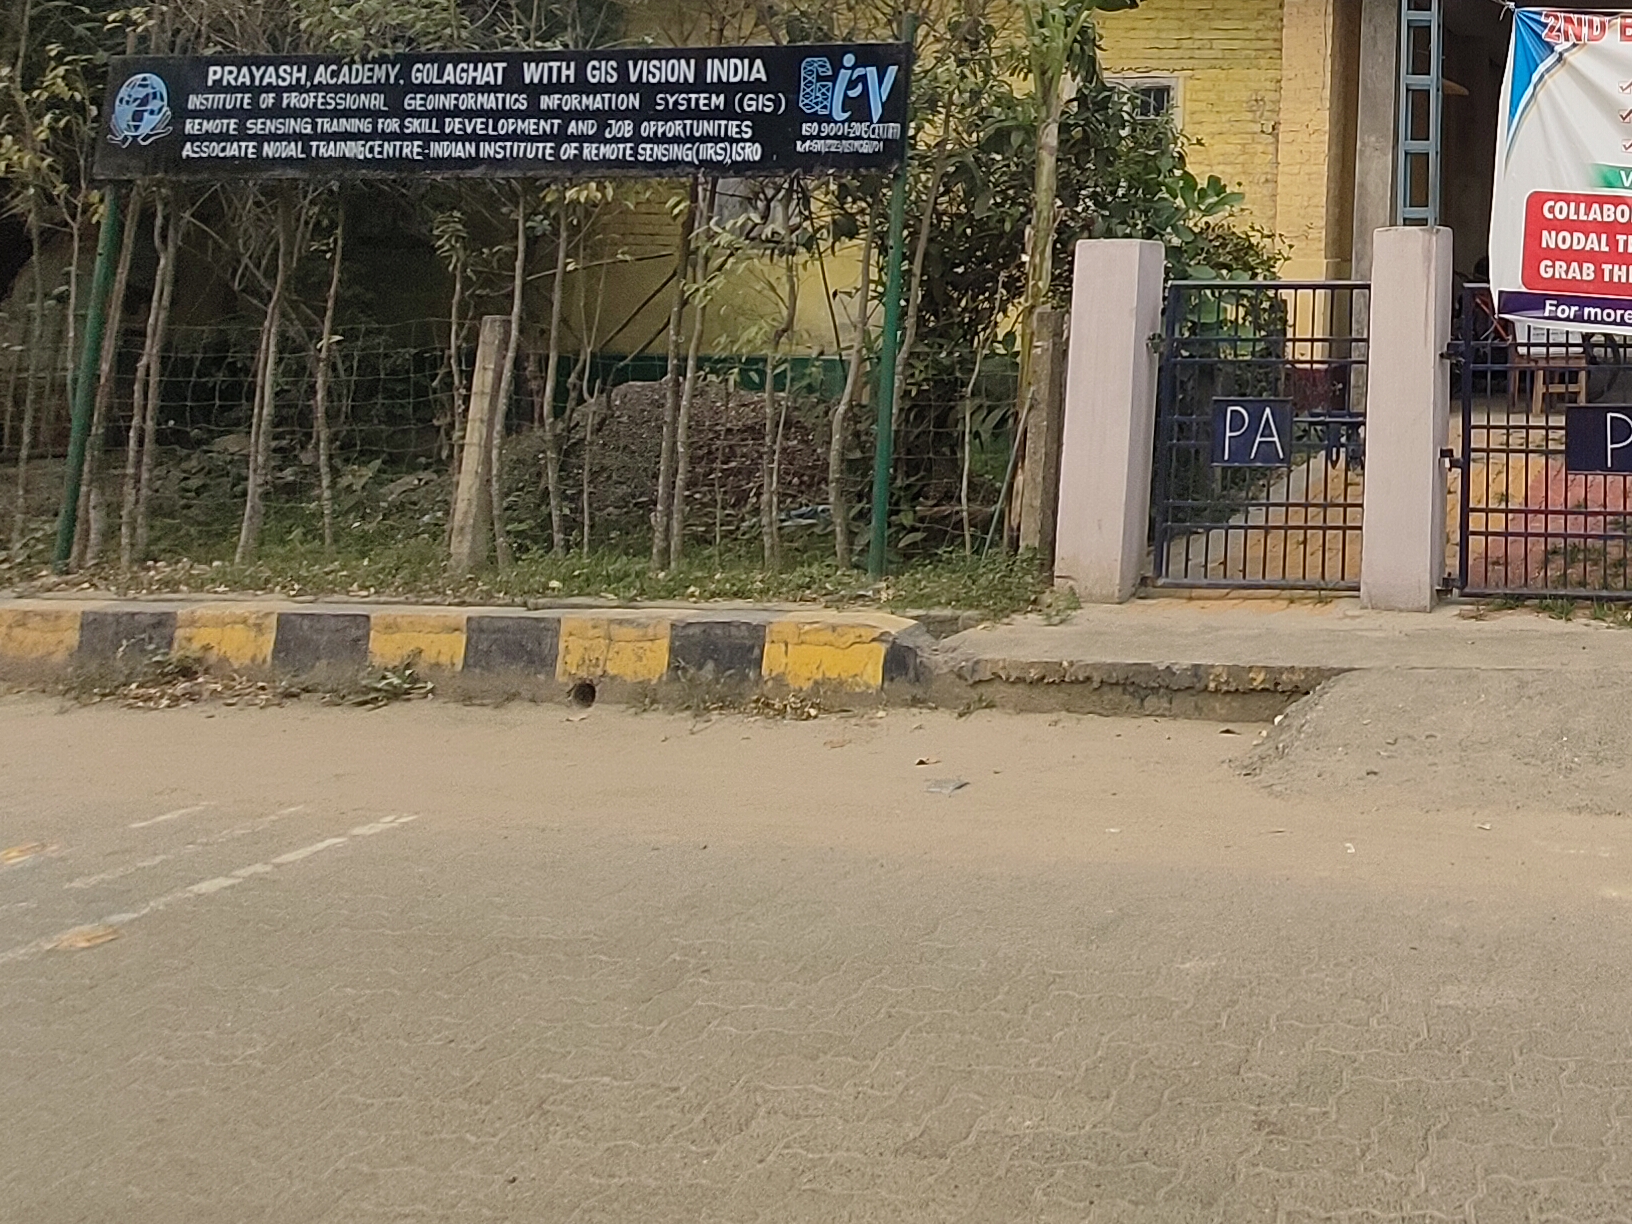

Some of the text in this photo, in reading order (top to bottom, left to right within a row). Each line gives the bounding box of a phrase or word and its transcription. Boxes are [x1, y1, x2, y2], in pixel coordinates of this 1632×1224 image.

[411, 58, 767, 85] GOLAGHAT WITH GIS VISION INDIA
[187, 92, 786, 115] INSTITUTE OF PROFESSIONAL GEOINFORMATICS INFORMATION SYSTEM (GIS)
[184, 118, 753, 138] REMOTE TRAINING FOR SKILL DEVELOPMENT AND JOB OPPORTUNITIES
[182, 141, 635, 161] ASSOCIATE NODAL INSTITUTE OF REMOTE
[1541, 230, 1609, 253] NODAL
[1539, 260, 1595, 281] GRAB
[1544, 299, 1579, 319] For
[1222, 405, 1285, 461] PA
